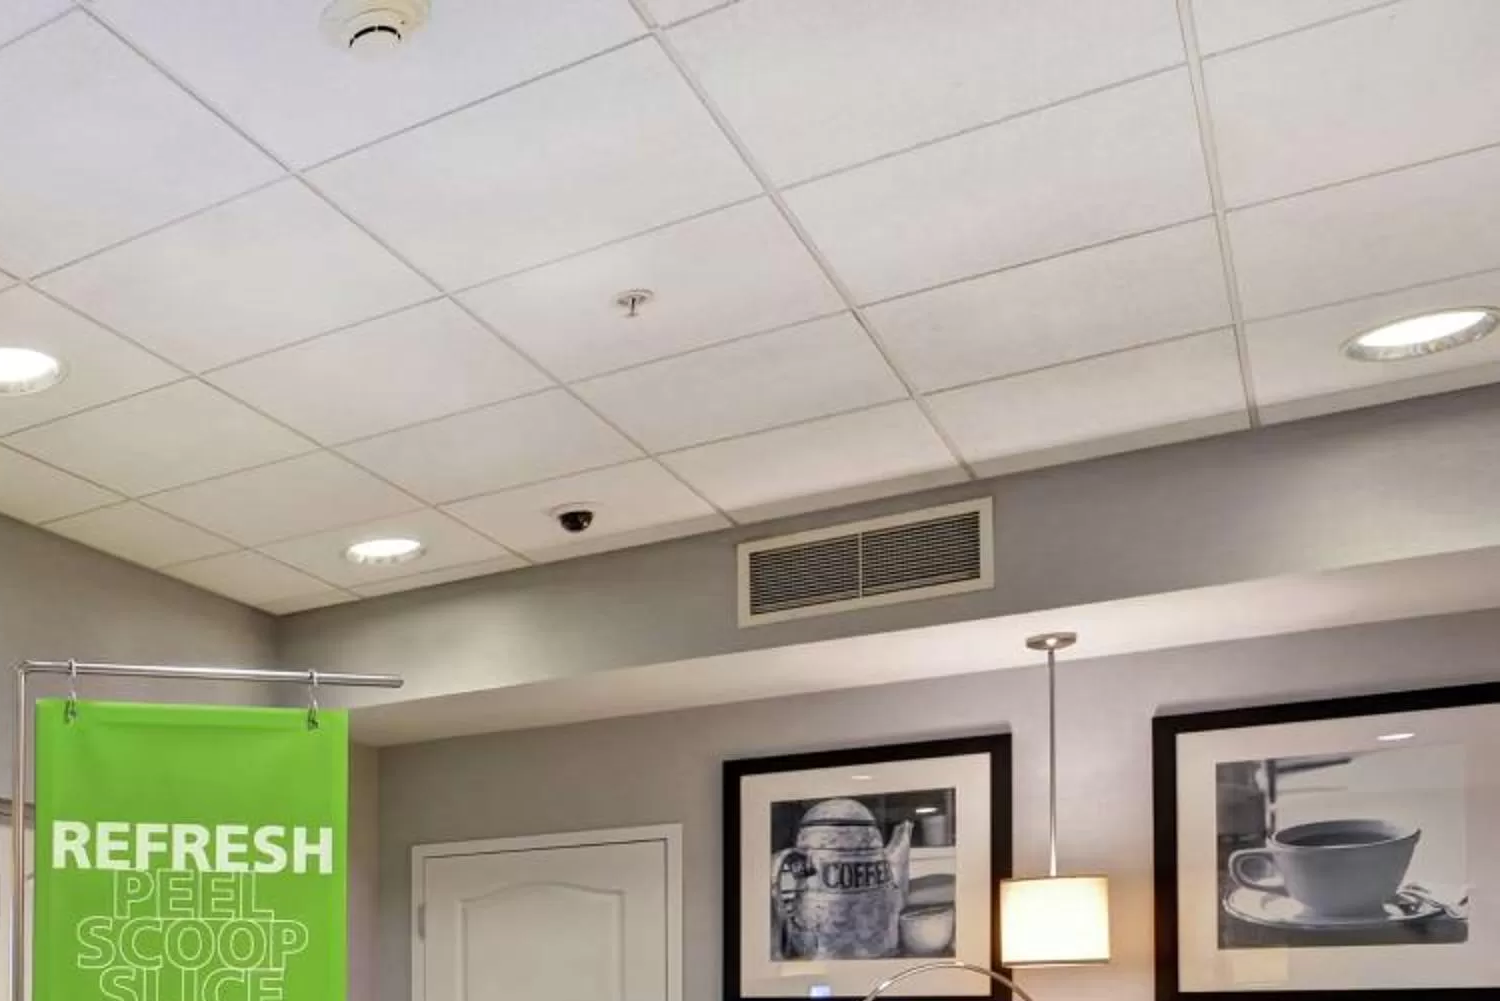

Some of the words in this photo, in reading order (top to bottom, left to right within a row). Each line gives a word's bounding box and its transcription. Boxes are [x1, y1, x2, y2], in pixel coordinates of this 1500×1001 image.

[52, 820, 333, 875] REFRESH
[114, 868, 275, 920] PEEL
[77, 916, 309, 971] SCOOP
